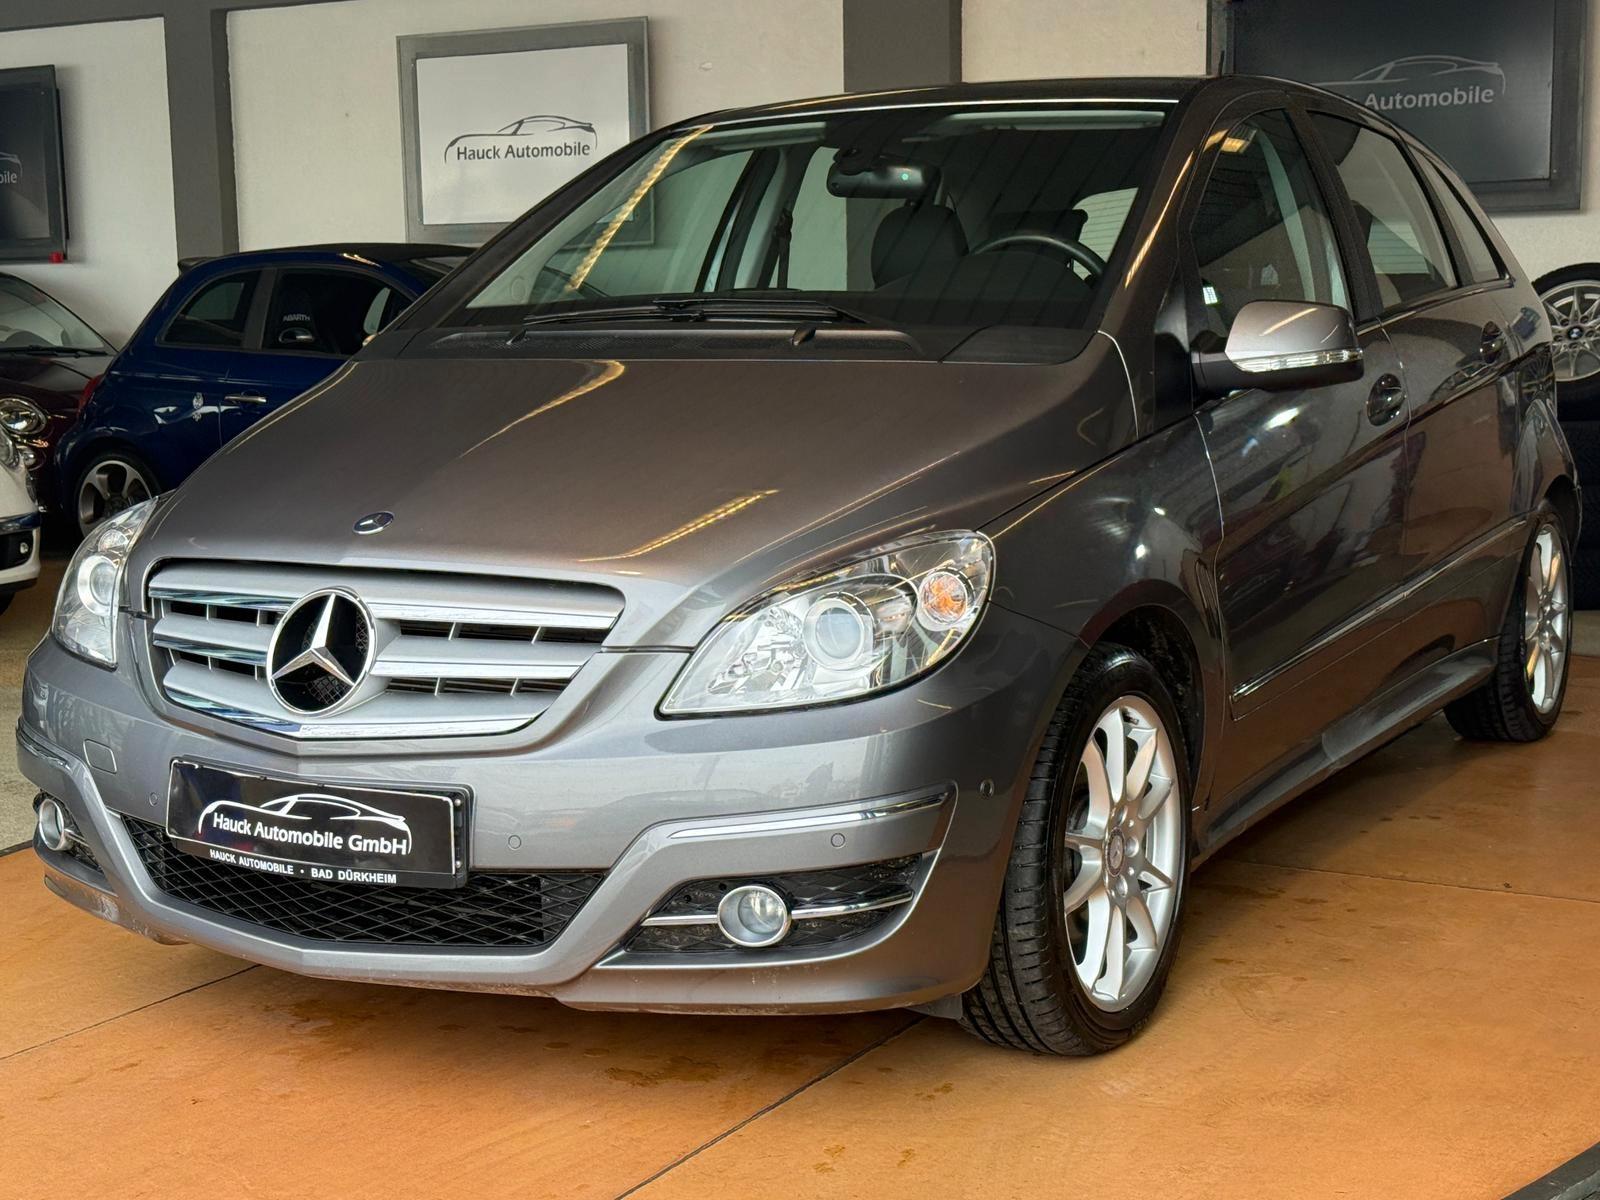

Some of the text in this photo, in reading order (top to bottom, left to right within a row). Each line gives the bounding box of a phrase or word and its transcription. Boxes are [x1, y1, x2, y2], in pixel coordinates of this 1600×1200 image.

[1364, 86, 1494, 110] Automobile
[457, 142, 590, 160] Hauck Automobile
[283, 313, 310, 321] ABARTH
[213, 812, 407, 855] Hauck Automobile GmbH
[210, 849, 397, 884] HAUCK AUTOMOBILE BAD DÜRKHEIM
